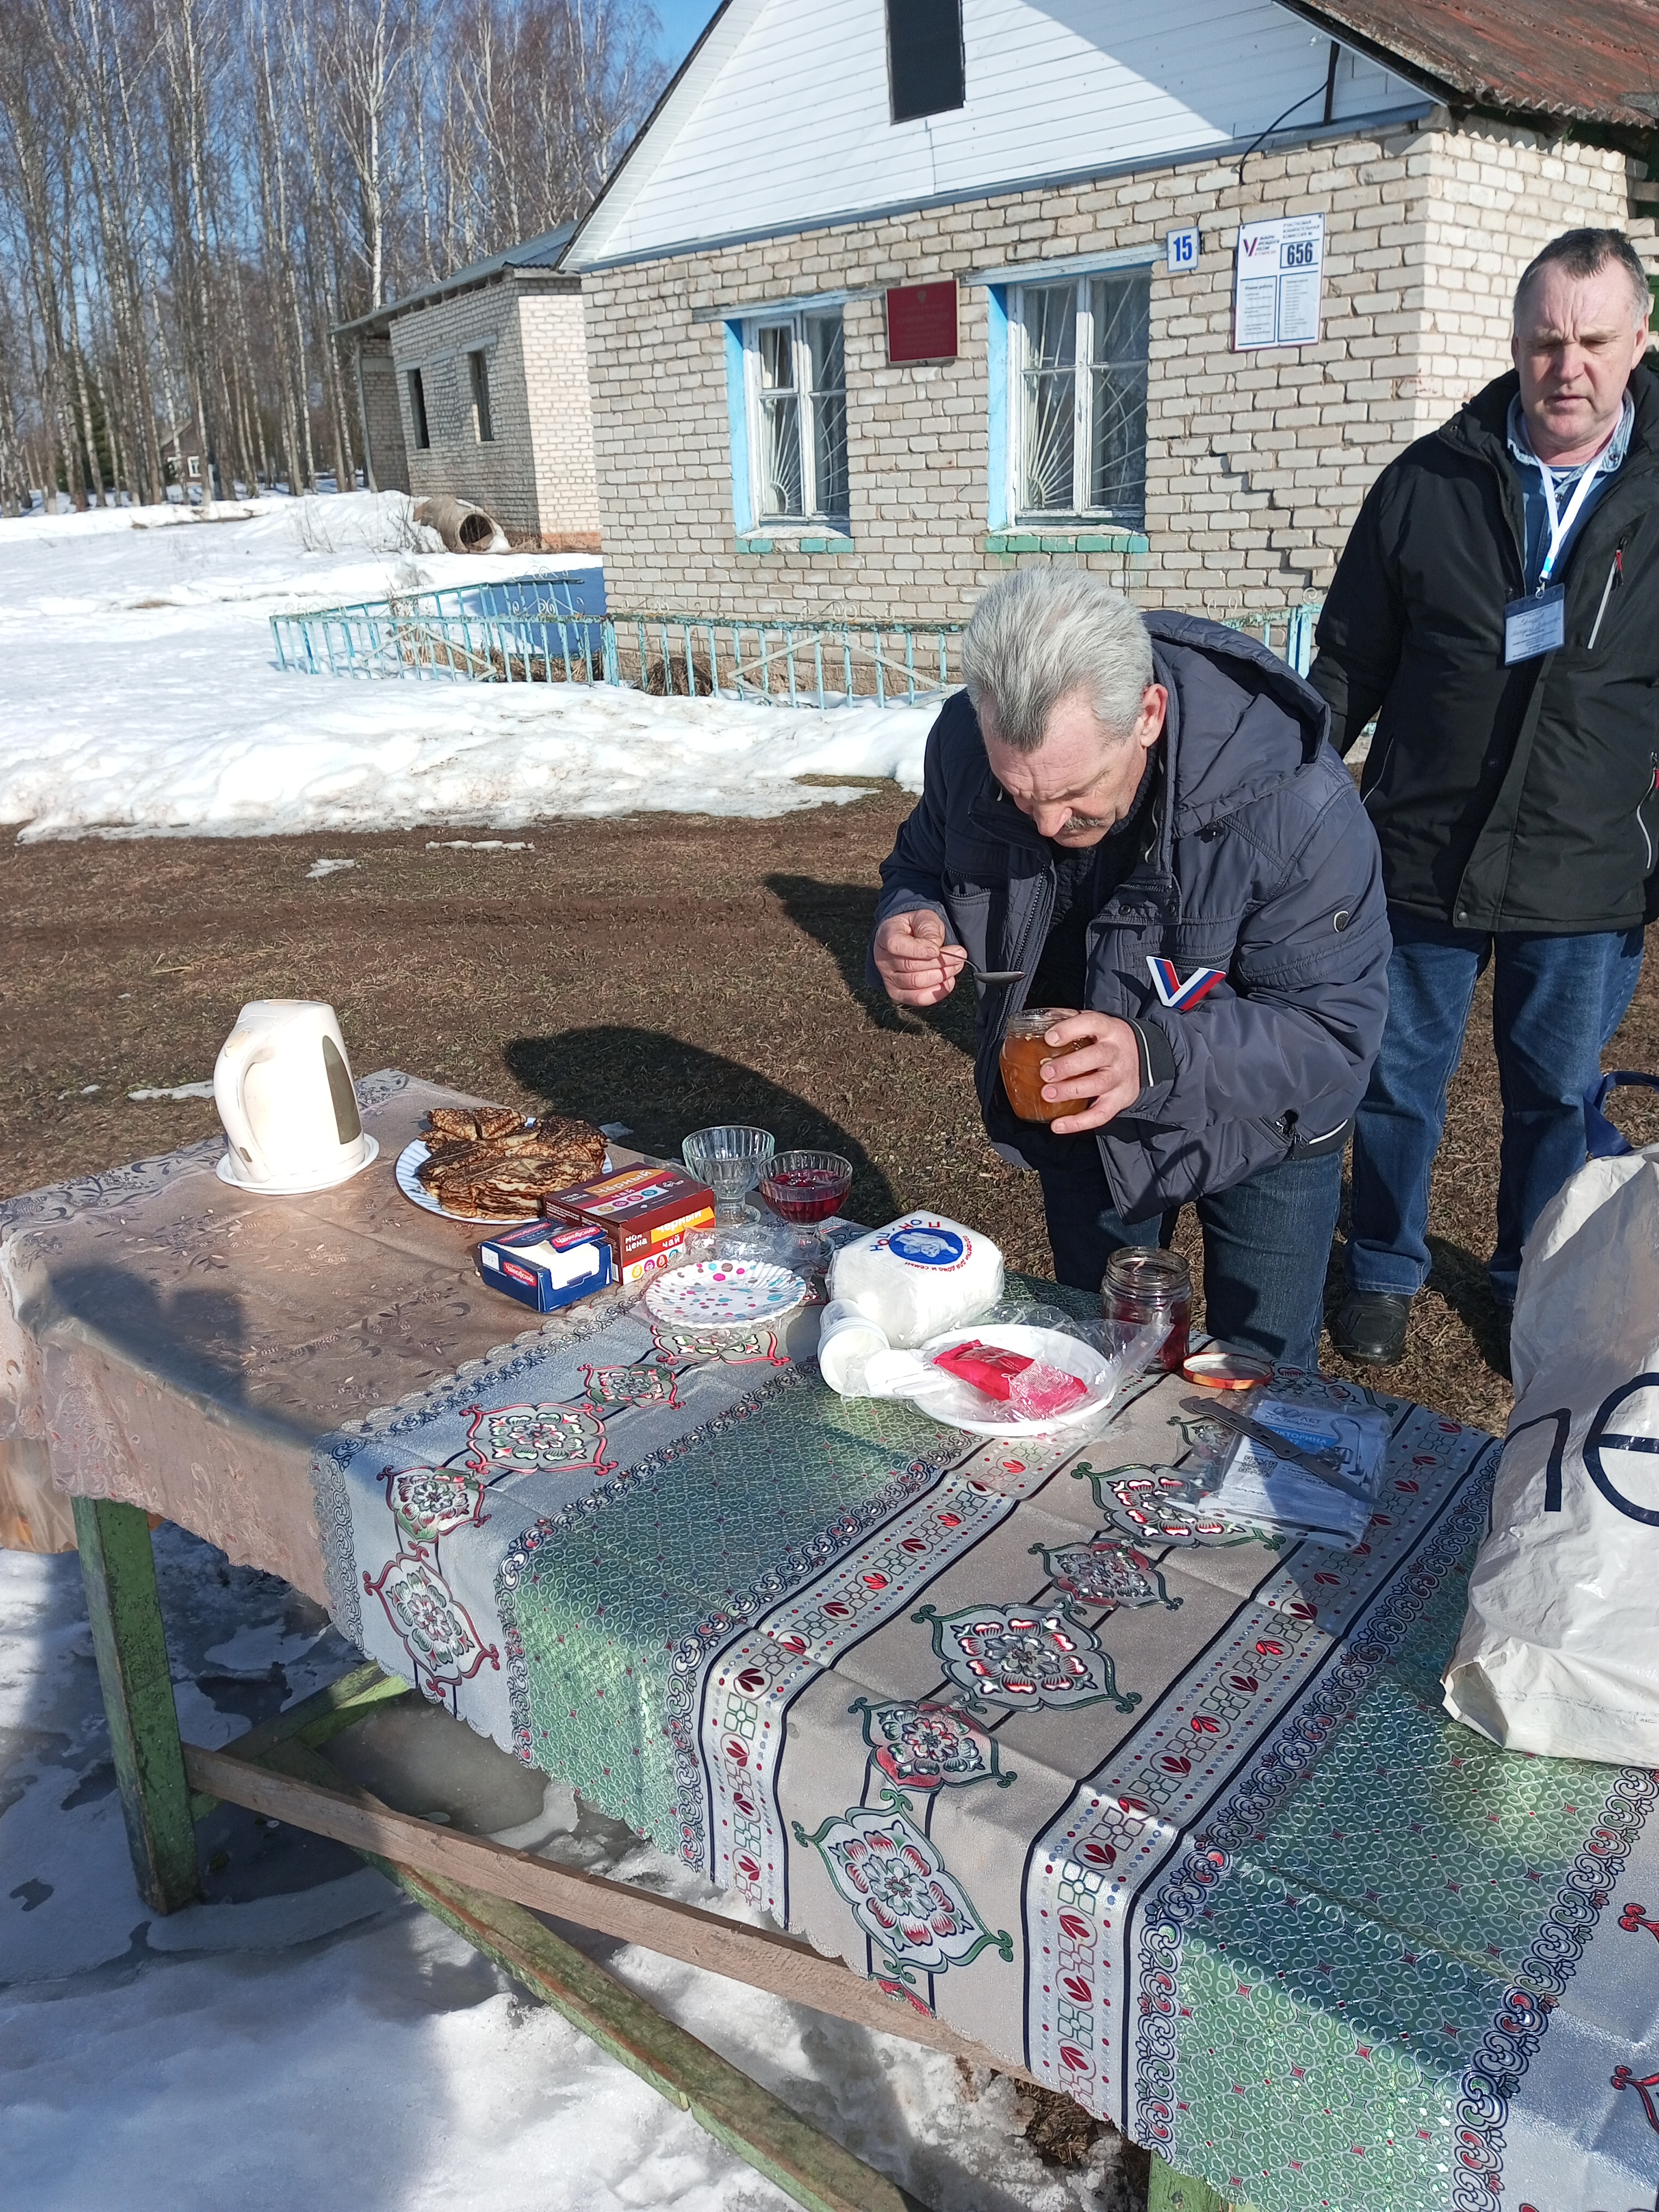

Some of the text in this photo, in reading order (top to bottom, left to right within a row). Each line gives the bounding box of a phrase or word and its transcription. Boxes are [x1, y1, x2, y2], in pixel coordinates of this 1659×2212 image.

[1173, 234, 1192, 262] 15
[1287, 240, 1313, 266] 656
[625, 1237, 648, 1252] цена
[661, 1233, 681, 1248] чай
[1272, 1429, 1327, 1445] ИКТОРИНА
